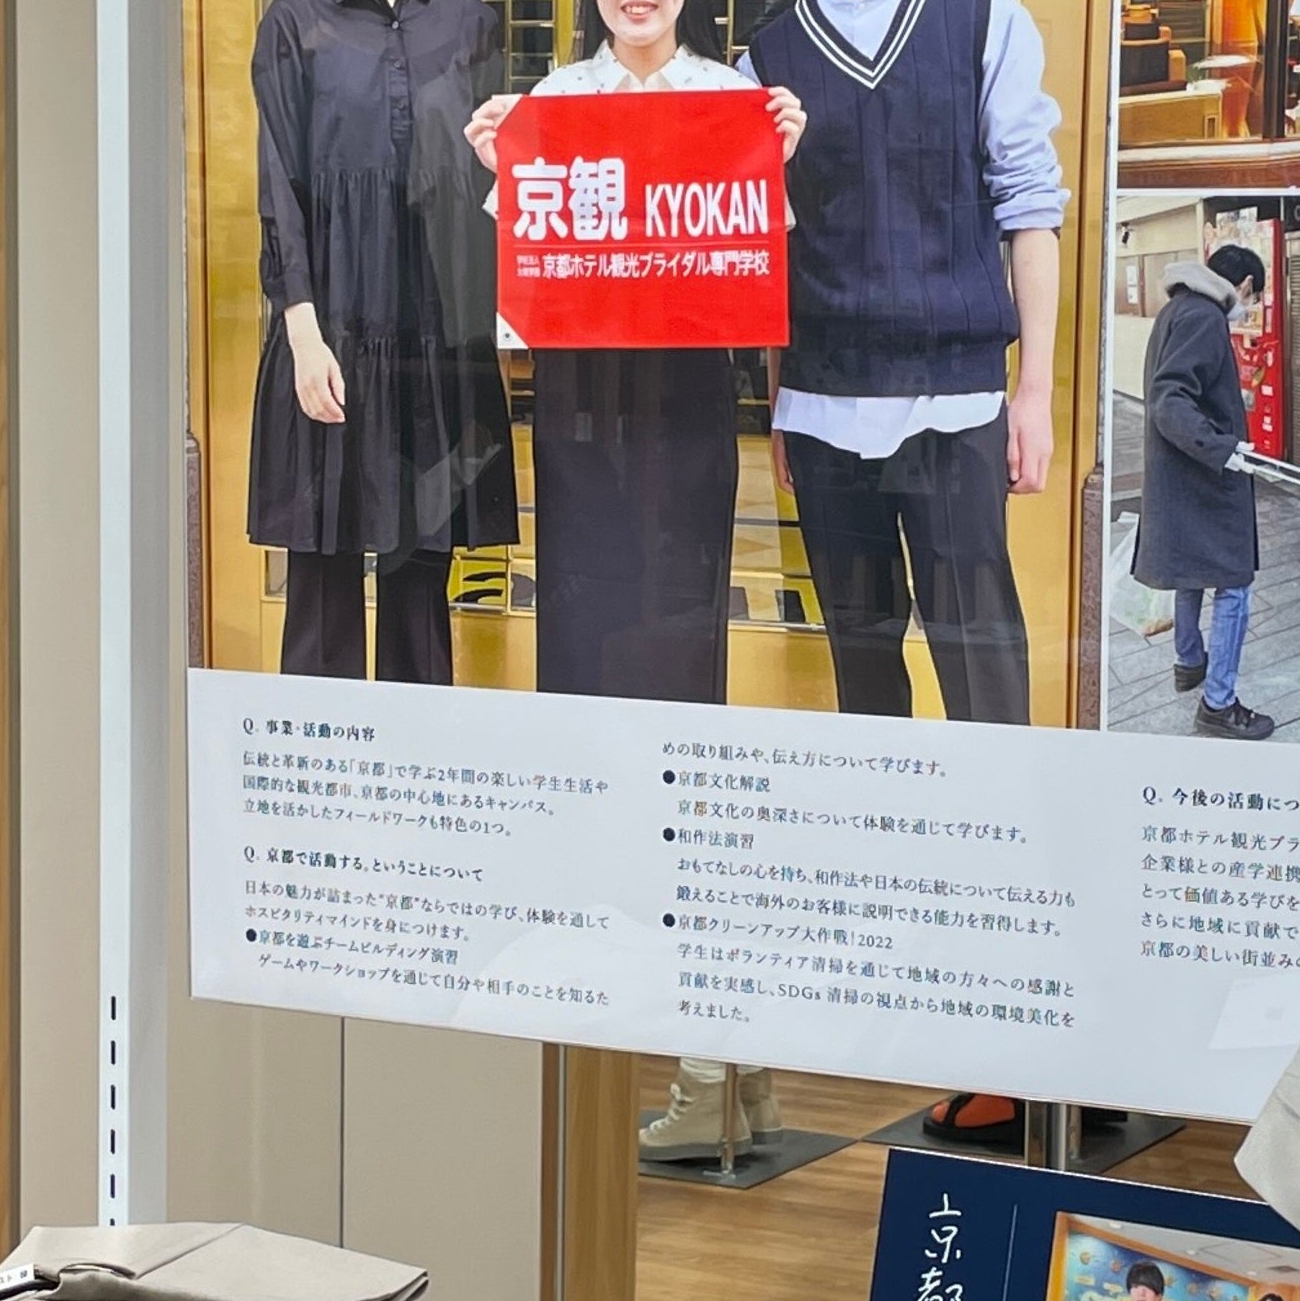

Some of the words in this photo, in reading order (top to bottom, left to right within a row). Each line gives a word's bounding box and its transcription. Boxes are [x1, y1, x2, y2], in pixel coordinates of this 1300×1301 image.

[510, 155, 628, 241] 京観
[644, 179, 770, 238] KYOKAN
[541, 250, 770, 280] 京都ホテル観光ブライダル専門学校
[265, 718, 376, 743] 事業・活動の内容
[661, 741, 948, 778] めの取り組みや、伝え方について学びます。
[677, 798, 1029, 844] 京都文化の奥深さについて体験を通じて学びます。
[677, 999, 752, 1023] 考えました。
